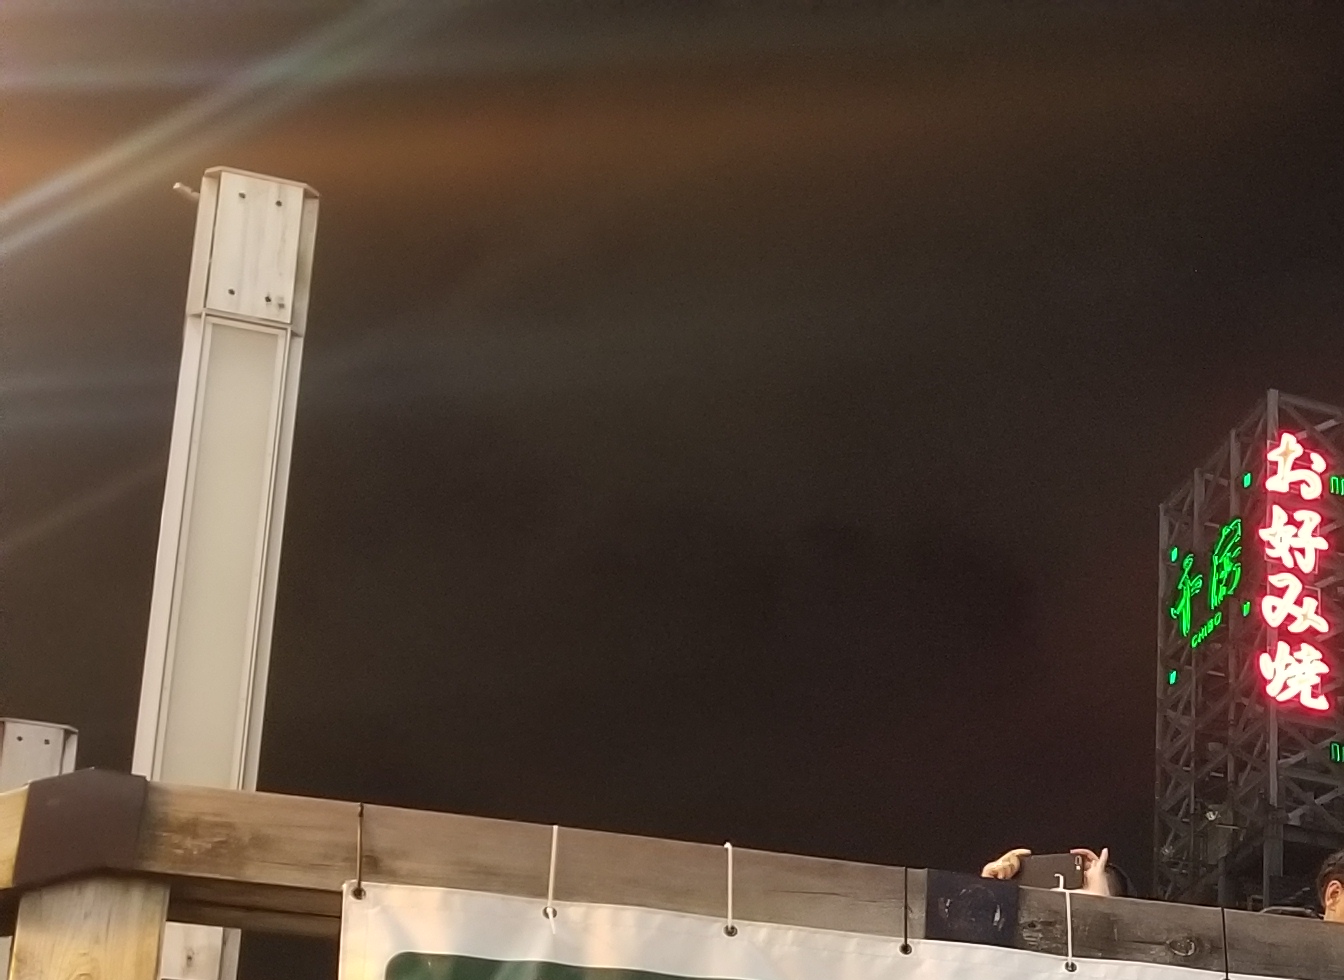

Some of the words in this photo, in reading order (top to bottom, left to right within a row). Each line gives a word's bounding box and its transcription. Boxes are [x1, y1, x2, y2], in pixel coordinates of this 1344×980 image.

[1191, 611, 1222, 648] CHIBO
[1258, 432, 1329, 710] お好み焼
